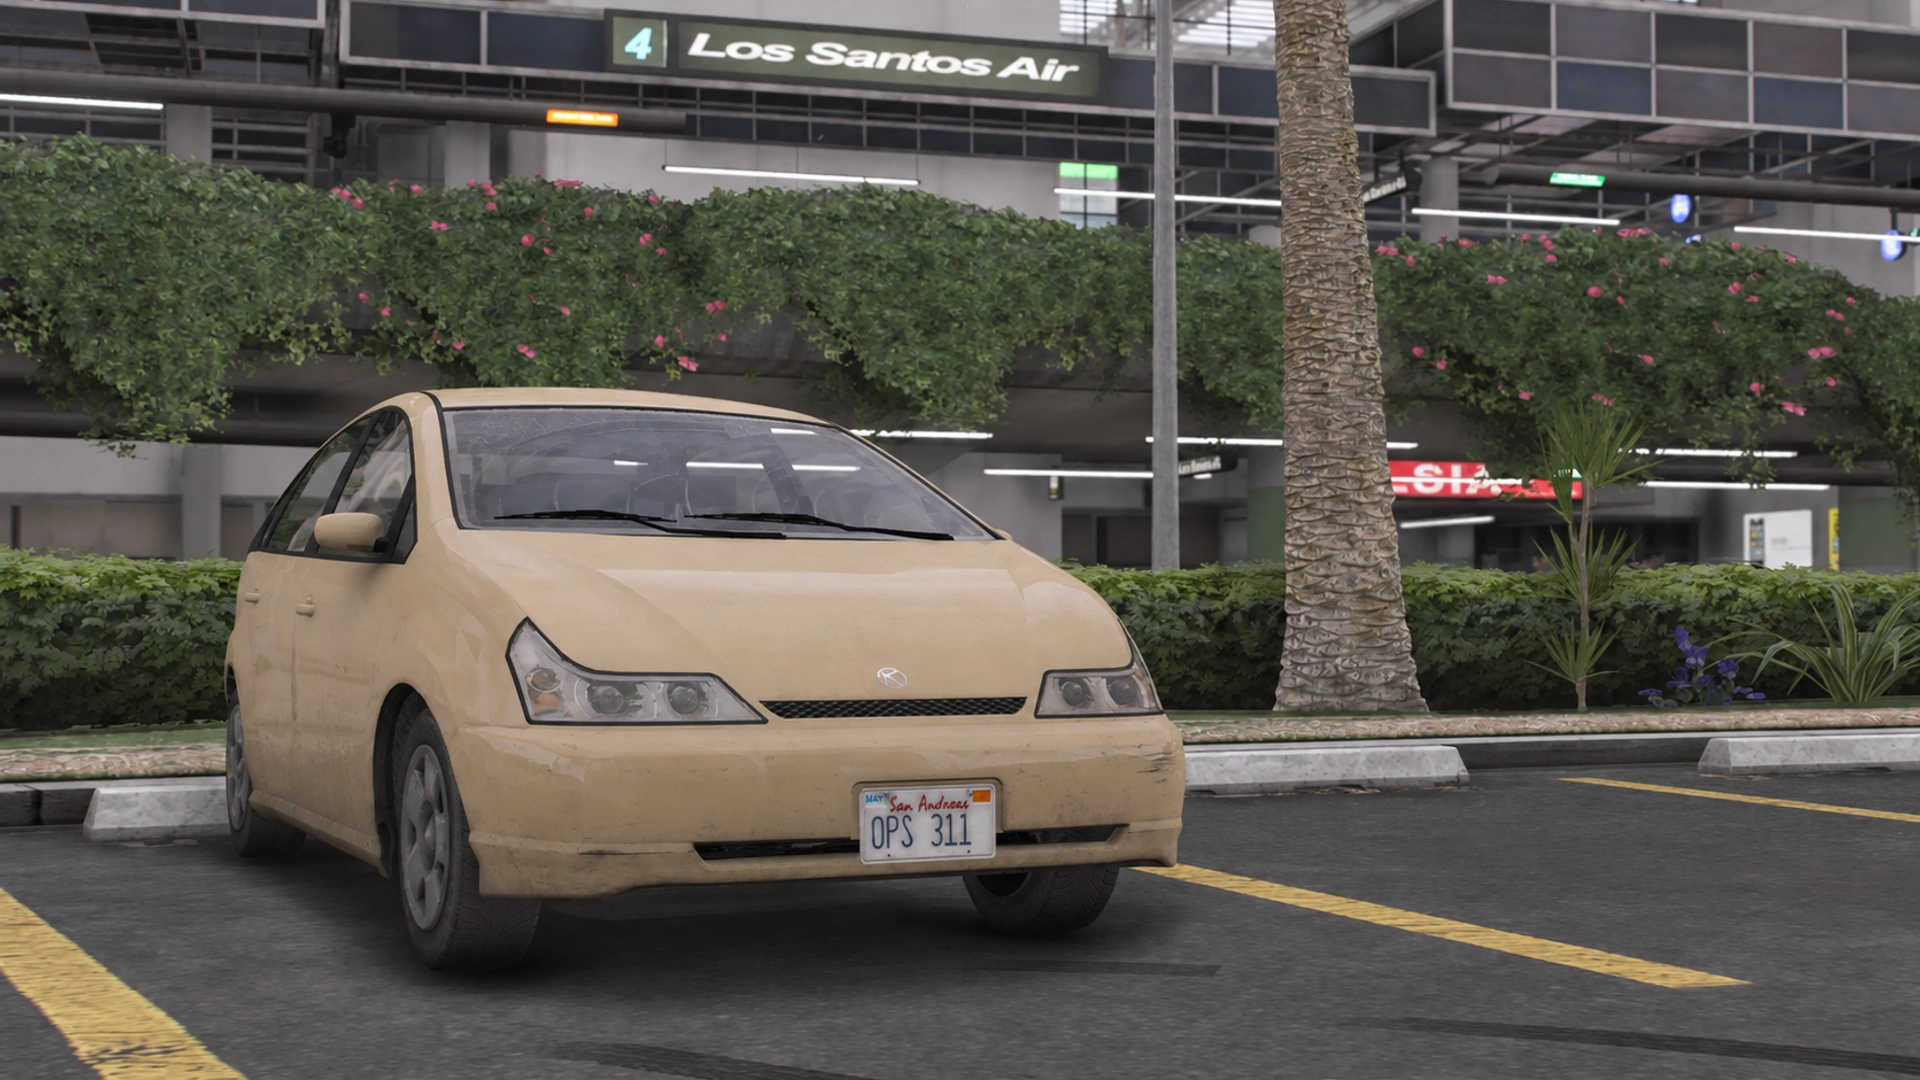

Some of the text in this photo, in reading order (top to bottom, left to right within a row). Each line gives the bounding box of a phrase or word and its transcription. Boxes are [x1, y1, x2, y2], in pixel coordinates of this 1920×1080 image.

[624, 27, 653, 60] 4
[688, 32, 1080, 82] Los Santos Air
[865, 794, 883, 804] MAY
[890, 794, 969, 812] San Andreas
[871, 813, 972, 849] OPS 311
